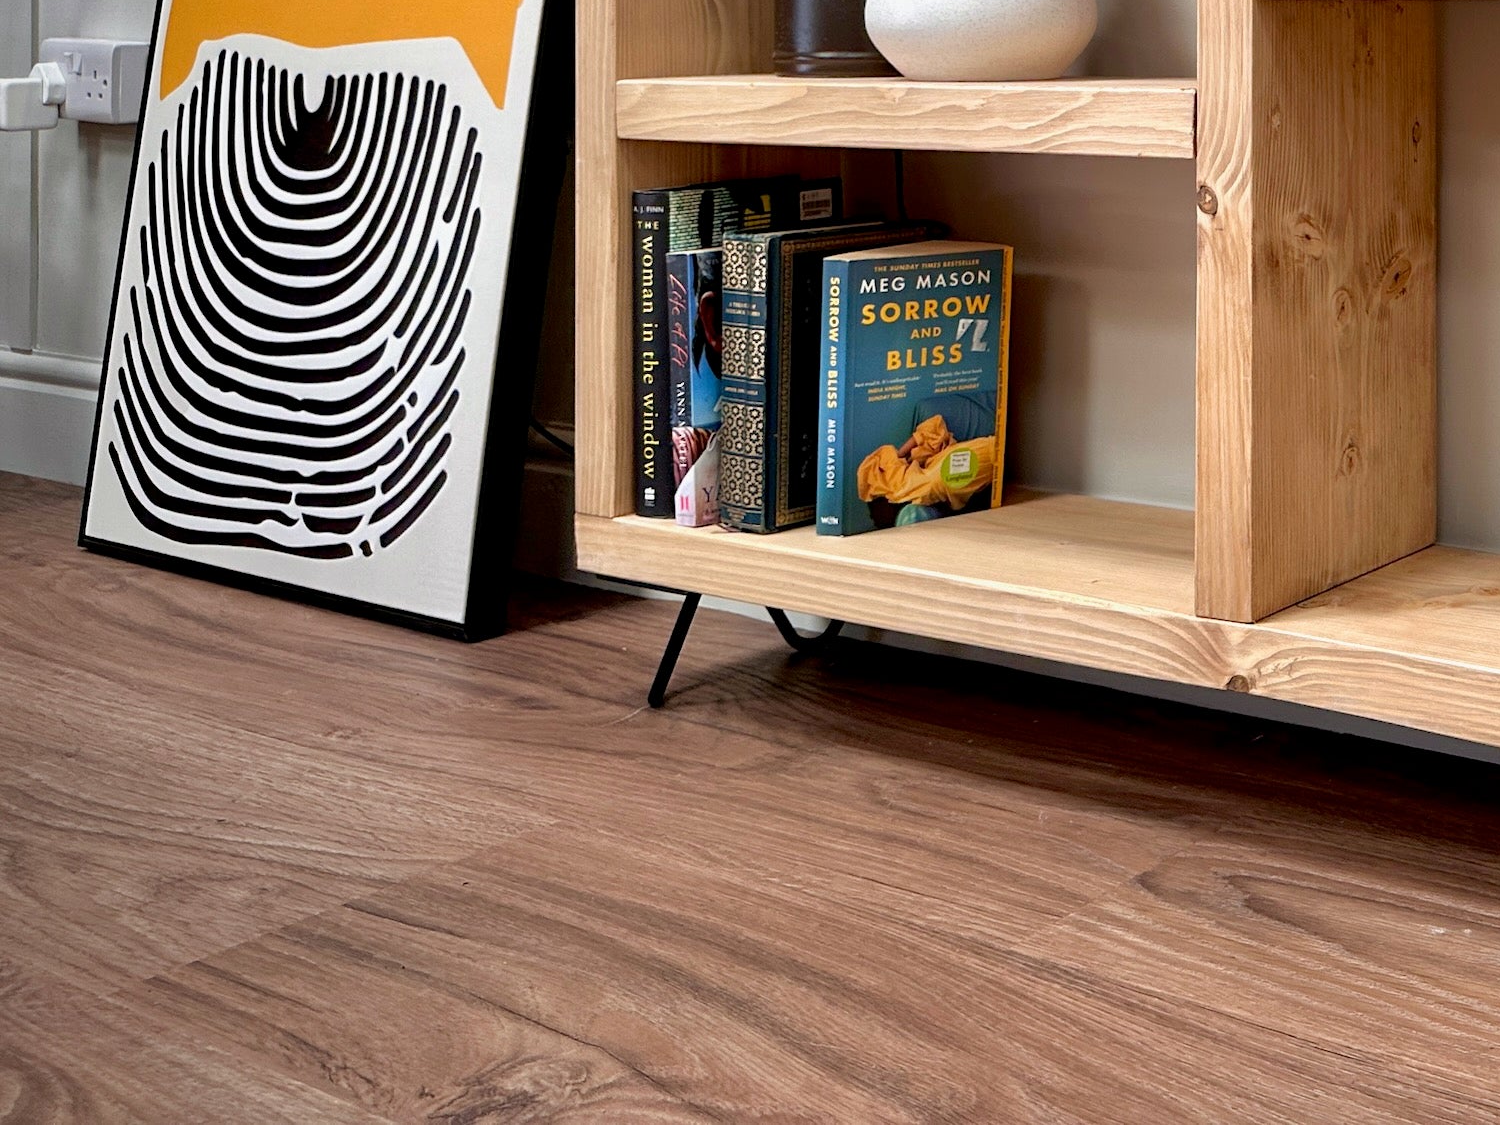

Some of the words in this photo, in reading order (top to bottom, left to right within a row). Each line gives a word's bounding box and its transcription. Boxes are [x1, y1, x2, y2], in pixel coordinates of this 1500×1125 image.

[637, 221, 660, 230] THE
[642, 235, 654, 313] woman
[874, 265, 887, 273] THE
[890, 263, 919, 272] SUNDAY
[921, 261, 941, 269] TIMES
[942, 259, 980, 268] BESTSELLER
[668, 273, 687, 316] Life
[859, 276, 906, 294] MEG
[916, 270, 991, 290] MASON
[828, 277, 840, 342] SORROW
[861, 294, 991, 325] SORROW
[642, 322, 659, 342] in
[910, 327, 942, 340] AND
[642, 350, 660, 385] the
[671, 343, 688, 369] Pi
[829, 346, 838, 367] AND
[886, 343, 963, 371] BLISS
[676, 381, 685, 417] YANN
[827, 370, 838, 409] BLISS
[642, 392, 660, 479] window
[827, 419, 836, 443] MEG
[826, 448, 836, 489] MASON
